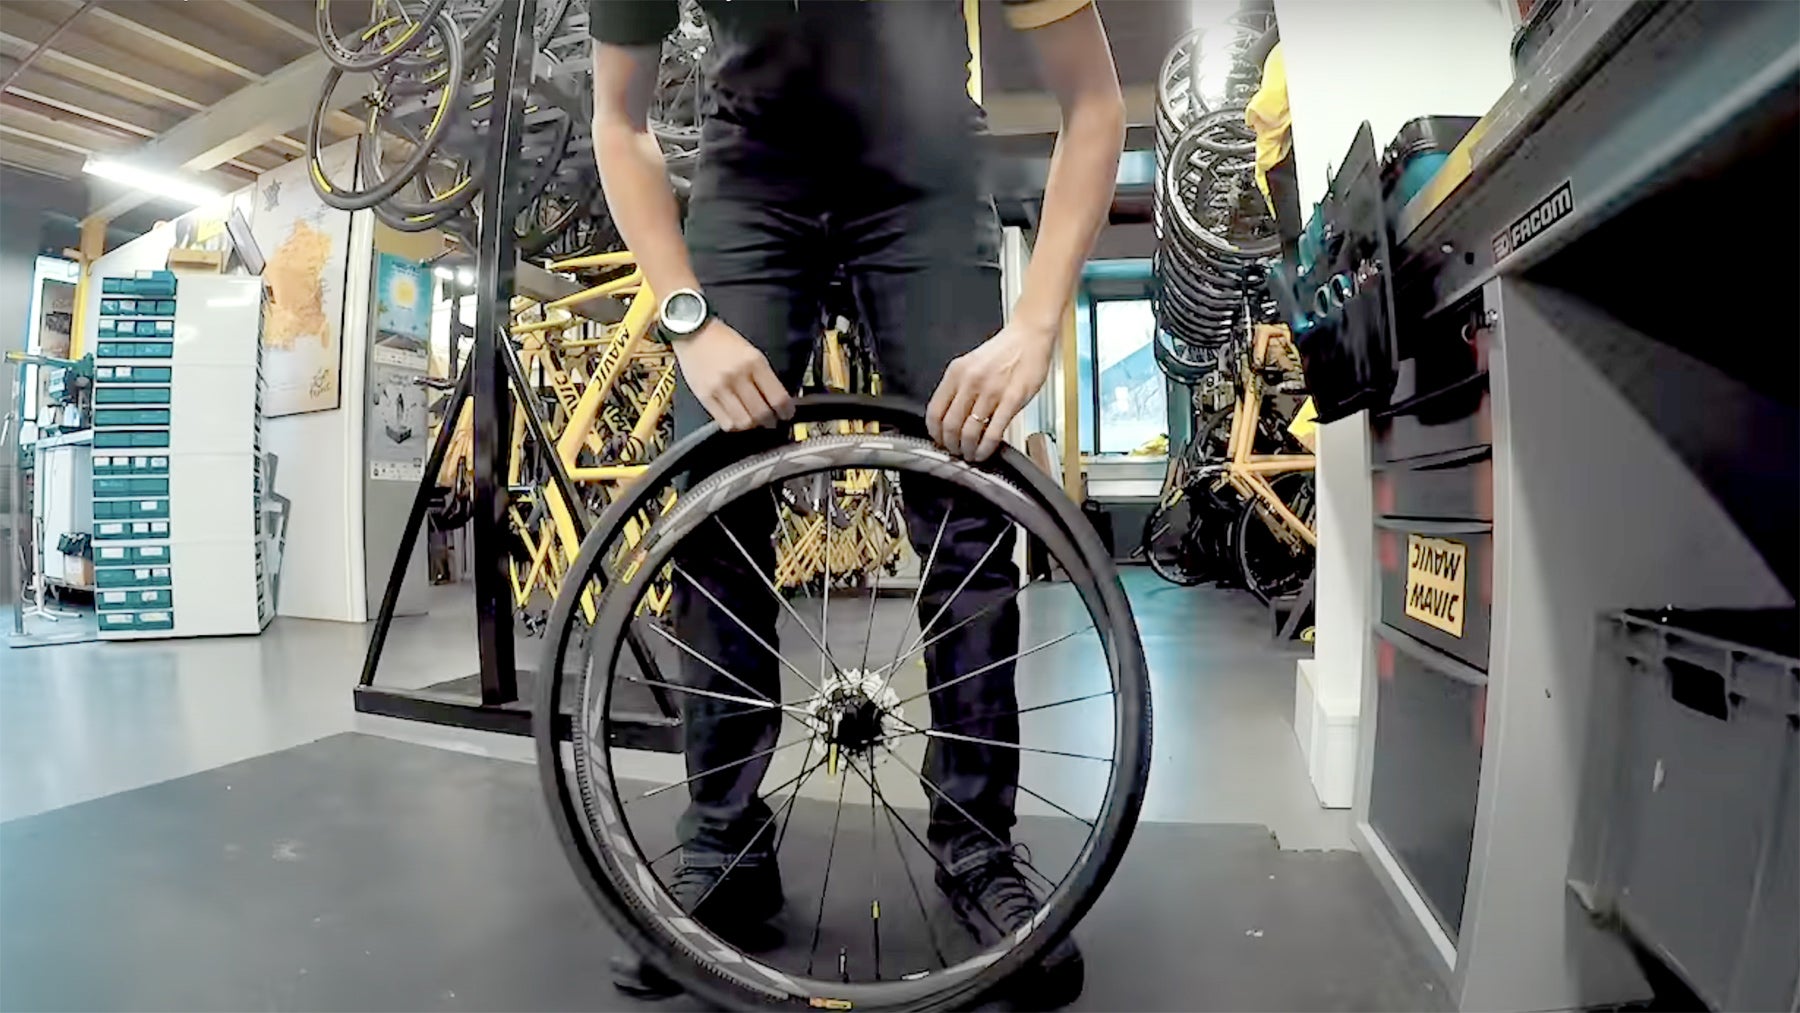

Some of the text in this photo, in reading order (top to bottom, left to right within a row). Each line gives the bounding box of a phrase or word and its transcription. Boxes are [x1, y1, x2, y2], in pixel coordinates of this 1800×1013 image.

[1511, 188, 1571, 248] FACOM
[596, 328, 630, 391] MAVIC
[1412, 543, 1461, 581] MAVIC
[1409, 583, 1460, 622] MAVIC
